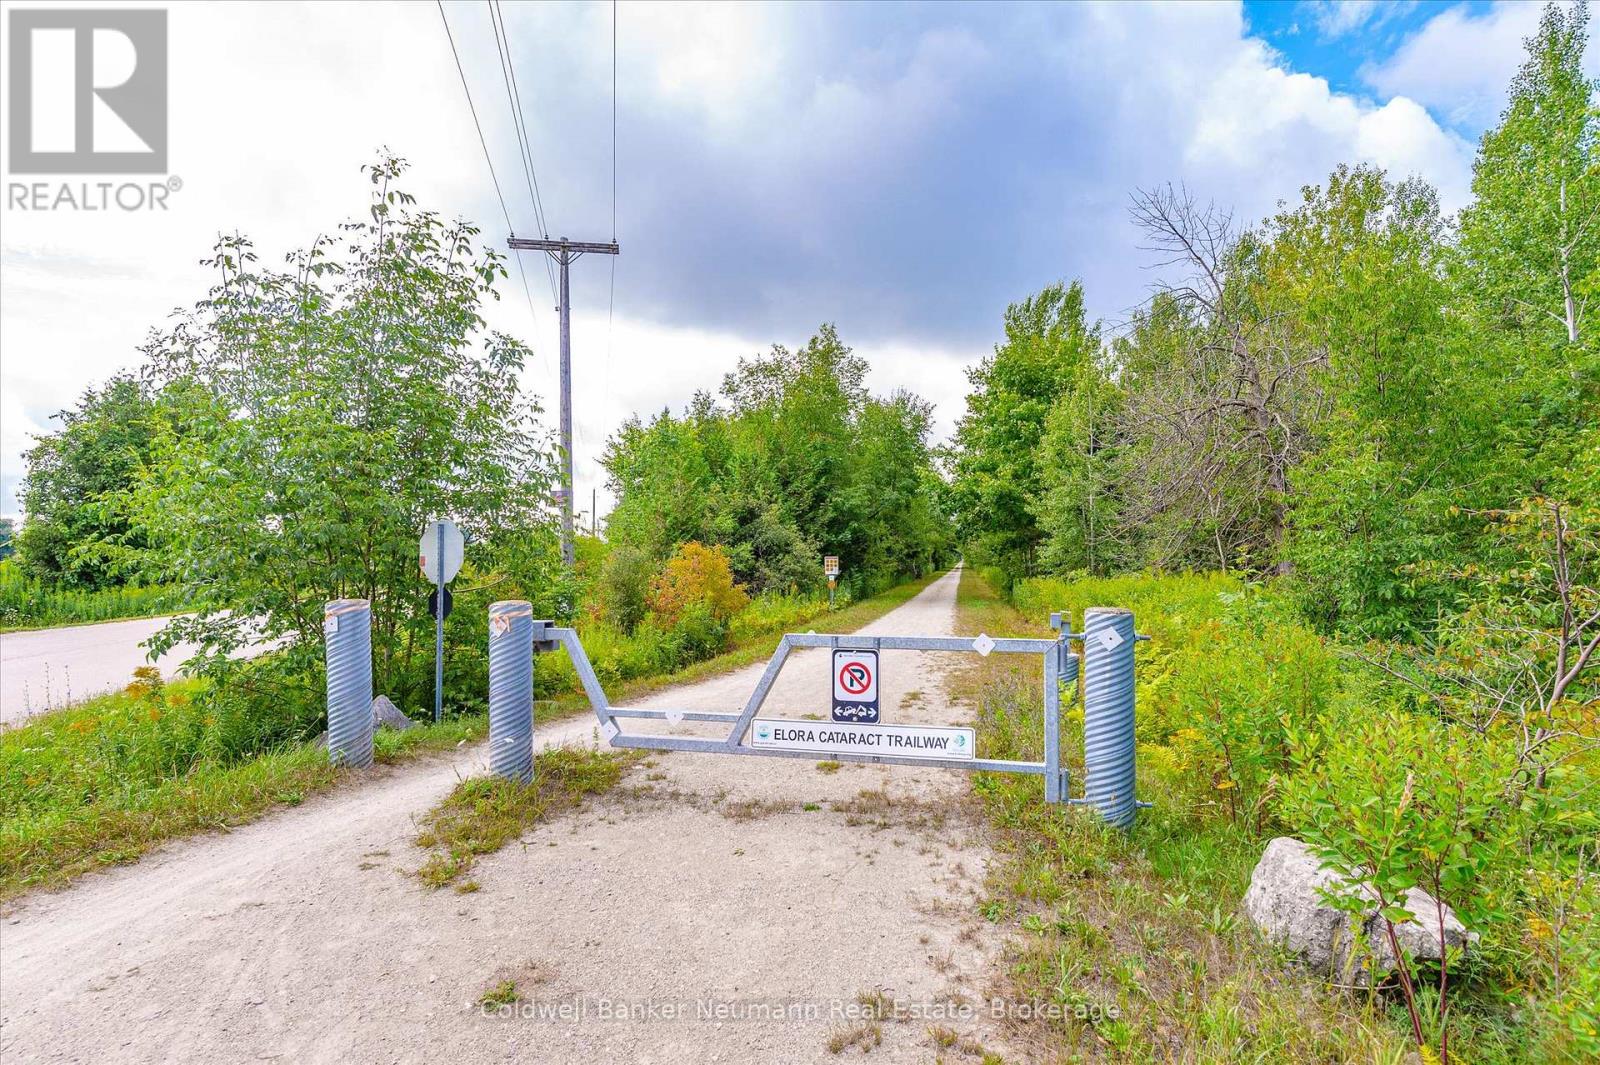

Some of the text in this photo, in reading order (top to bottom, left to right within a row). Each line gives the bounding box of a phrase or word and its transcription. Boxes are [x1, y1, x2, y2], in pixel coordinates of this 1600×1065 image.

[773, 728, 950, 751] ELORA CATARACT TRAILWAY
